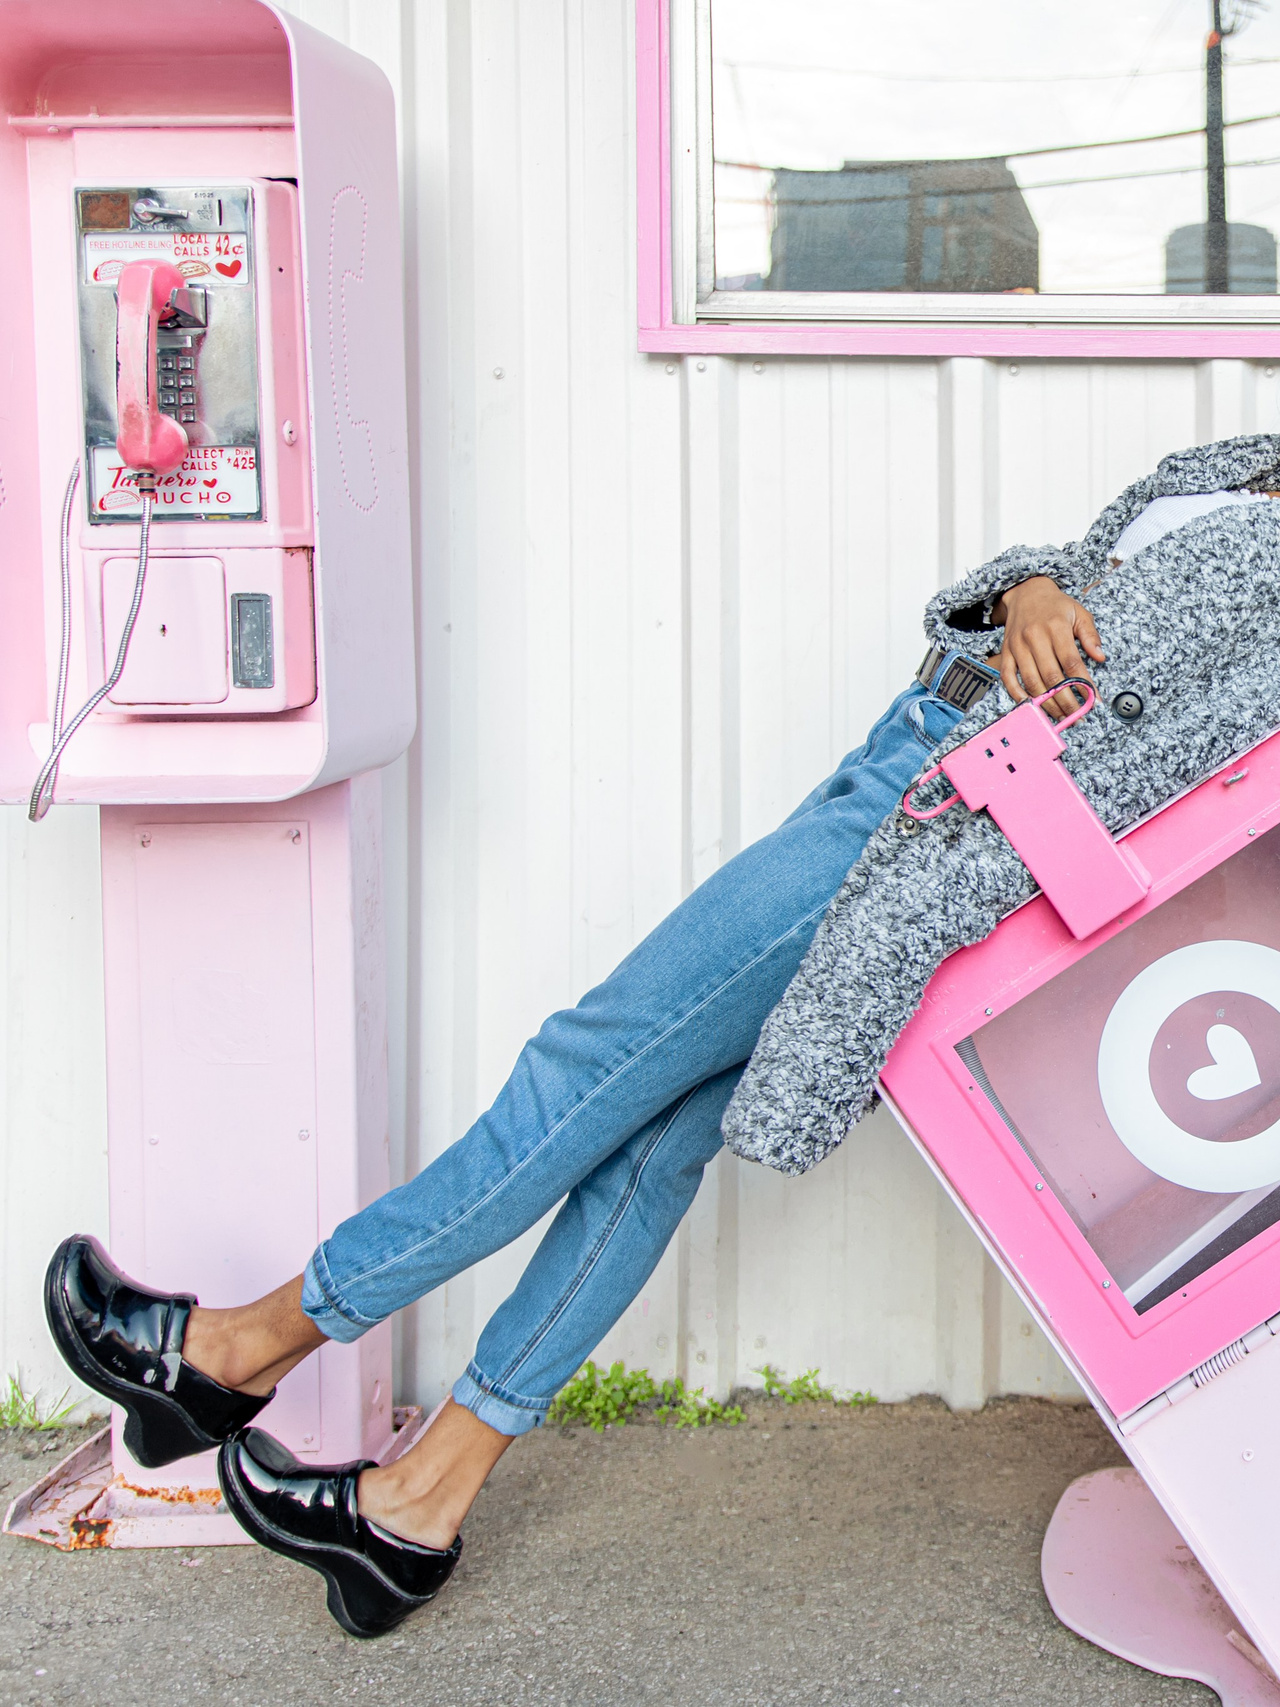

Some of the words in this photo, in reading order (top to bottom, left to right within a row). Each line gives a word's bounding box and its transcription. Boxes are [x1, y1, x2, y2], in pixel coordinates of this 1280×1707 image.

[173, 233, 210, 244] LOCAL
[89, 240, 110, 249] FREE
[112, 240, 146, 249] HOTLINE
[148, 240, 172, 249] BLING
[174, 246, 210, 256] CALLS
[186, 449, 224, 459] LLECT
[235, 448, 252, 456] Dial
[181, 461, 218, 471] CALLS
